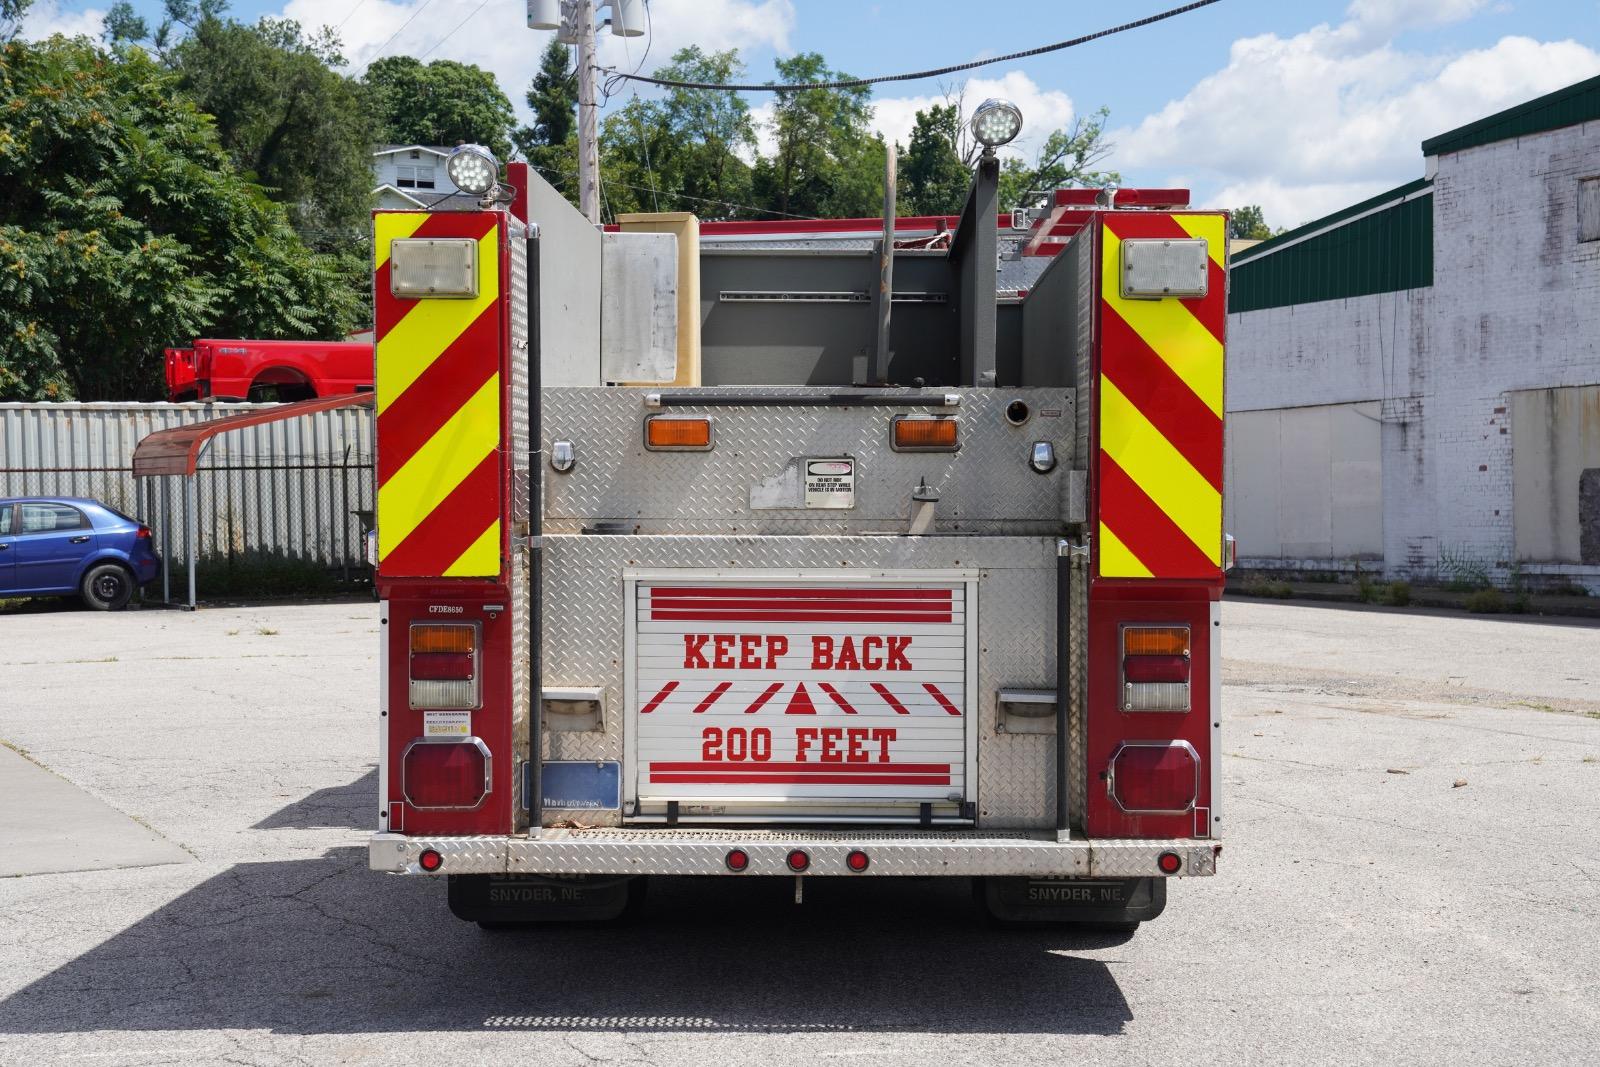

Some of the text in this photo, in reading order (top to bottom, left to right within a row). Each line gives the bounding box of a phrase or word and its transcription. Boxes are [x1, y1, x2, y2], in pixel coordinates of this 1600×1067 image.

[684, 634, 912, 671] KEEP BACK
[702, 727, 896, 762] 200 FEET
[489, 888, 557, 902] SNYDER,
[1029, 887, 1126, 902] SNYDER, NE.
